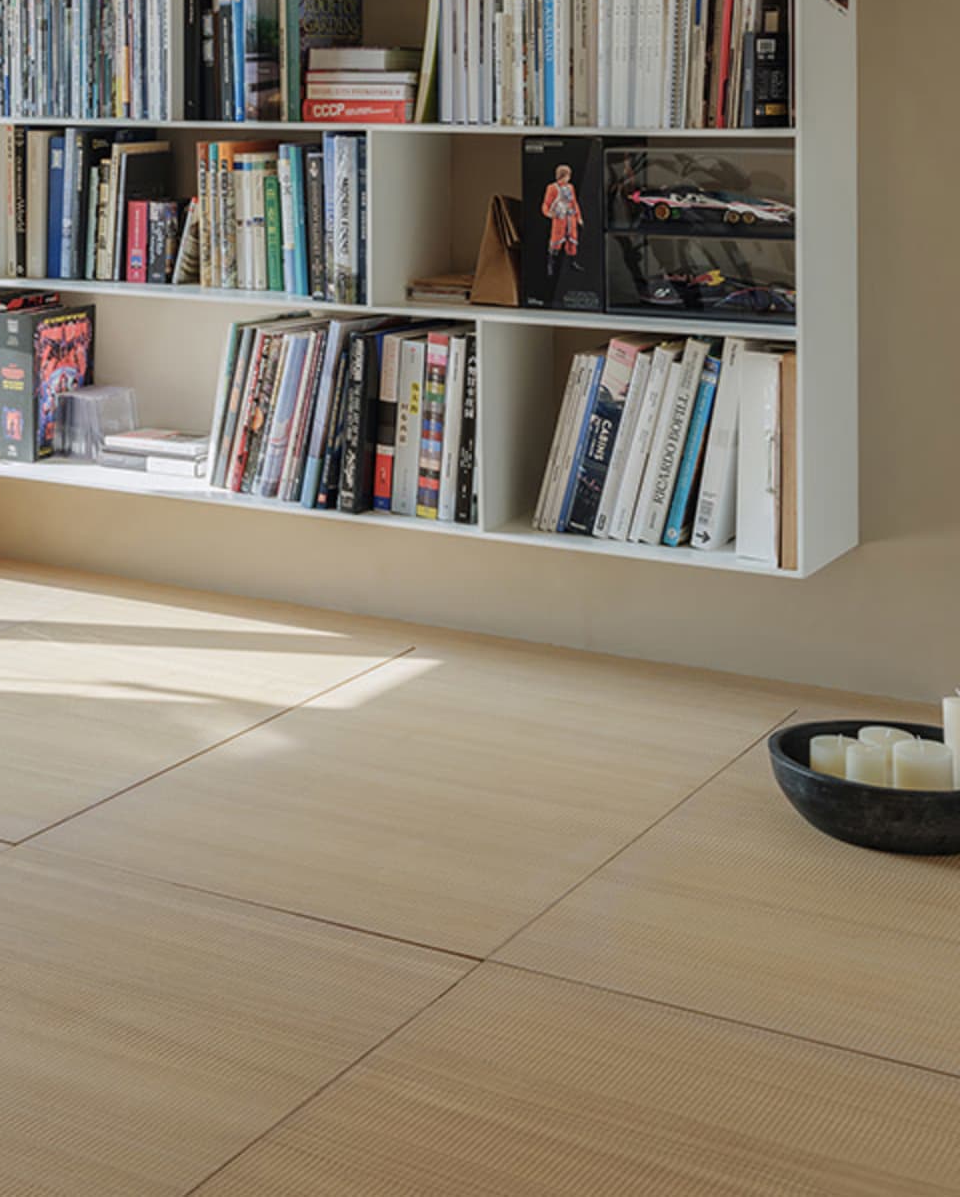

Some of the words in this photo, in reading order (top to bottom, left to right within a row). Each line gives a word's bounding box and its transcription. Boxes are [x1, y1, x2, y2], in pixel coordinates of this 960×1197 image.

[313, 103, 345, 118] CCCP
[593, 418, 613, 462] CABINS
[652, 441, 677, 505] RICARDO
[668, 393, 691, 440] BOFILL
